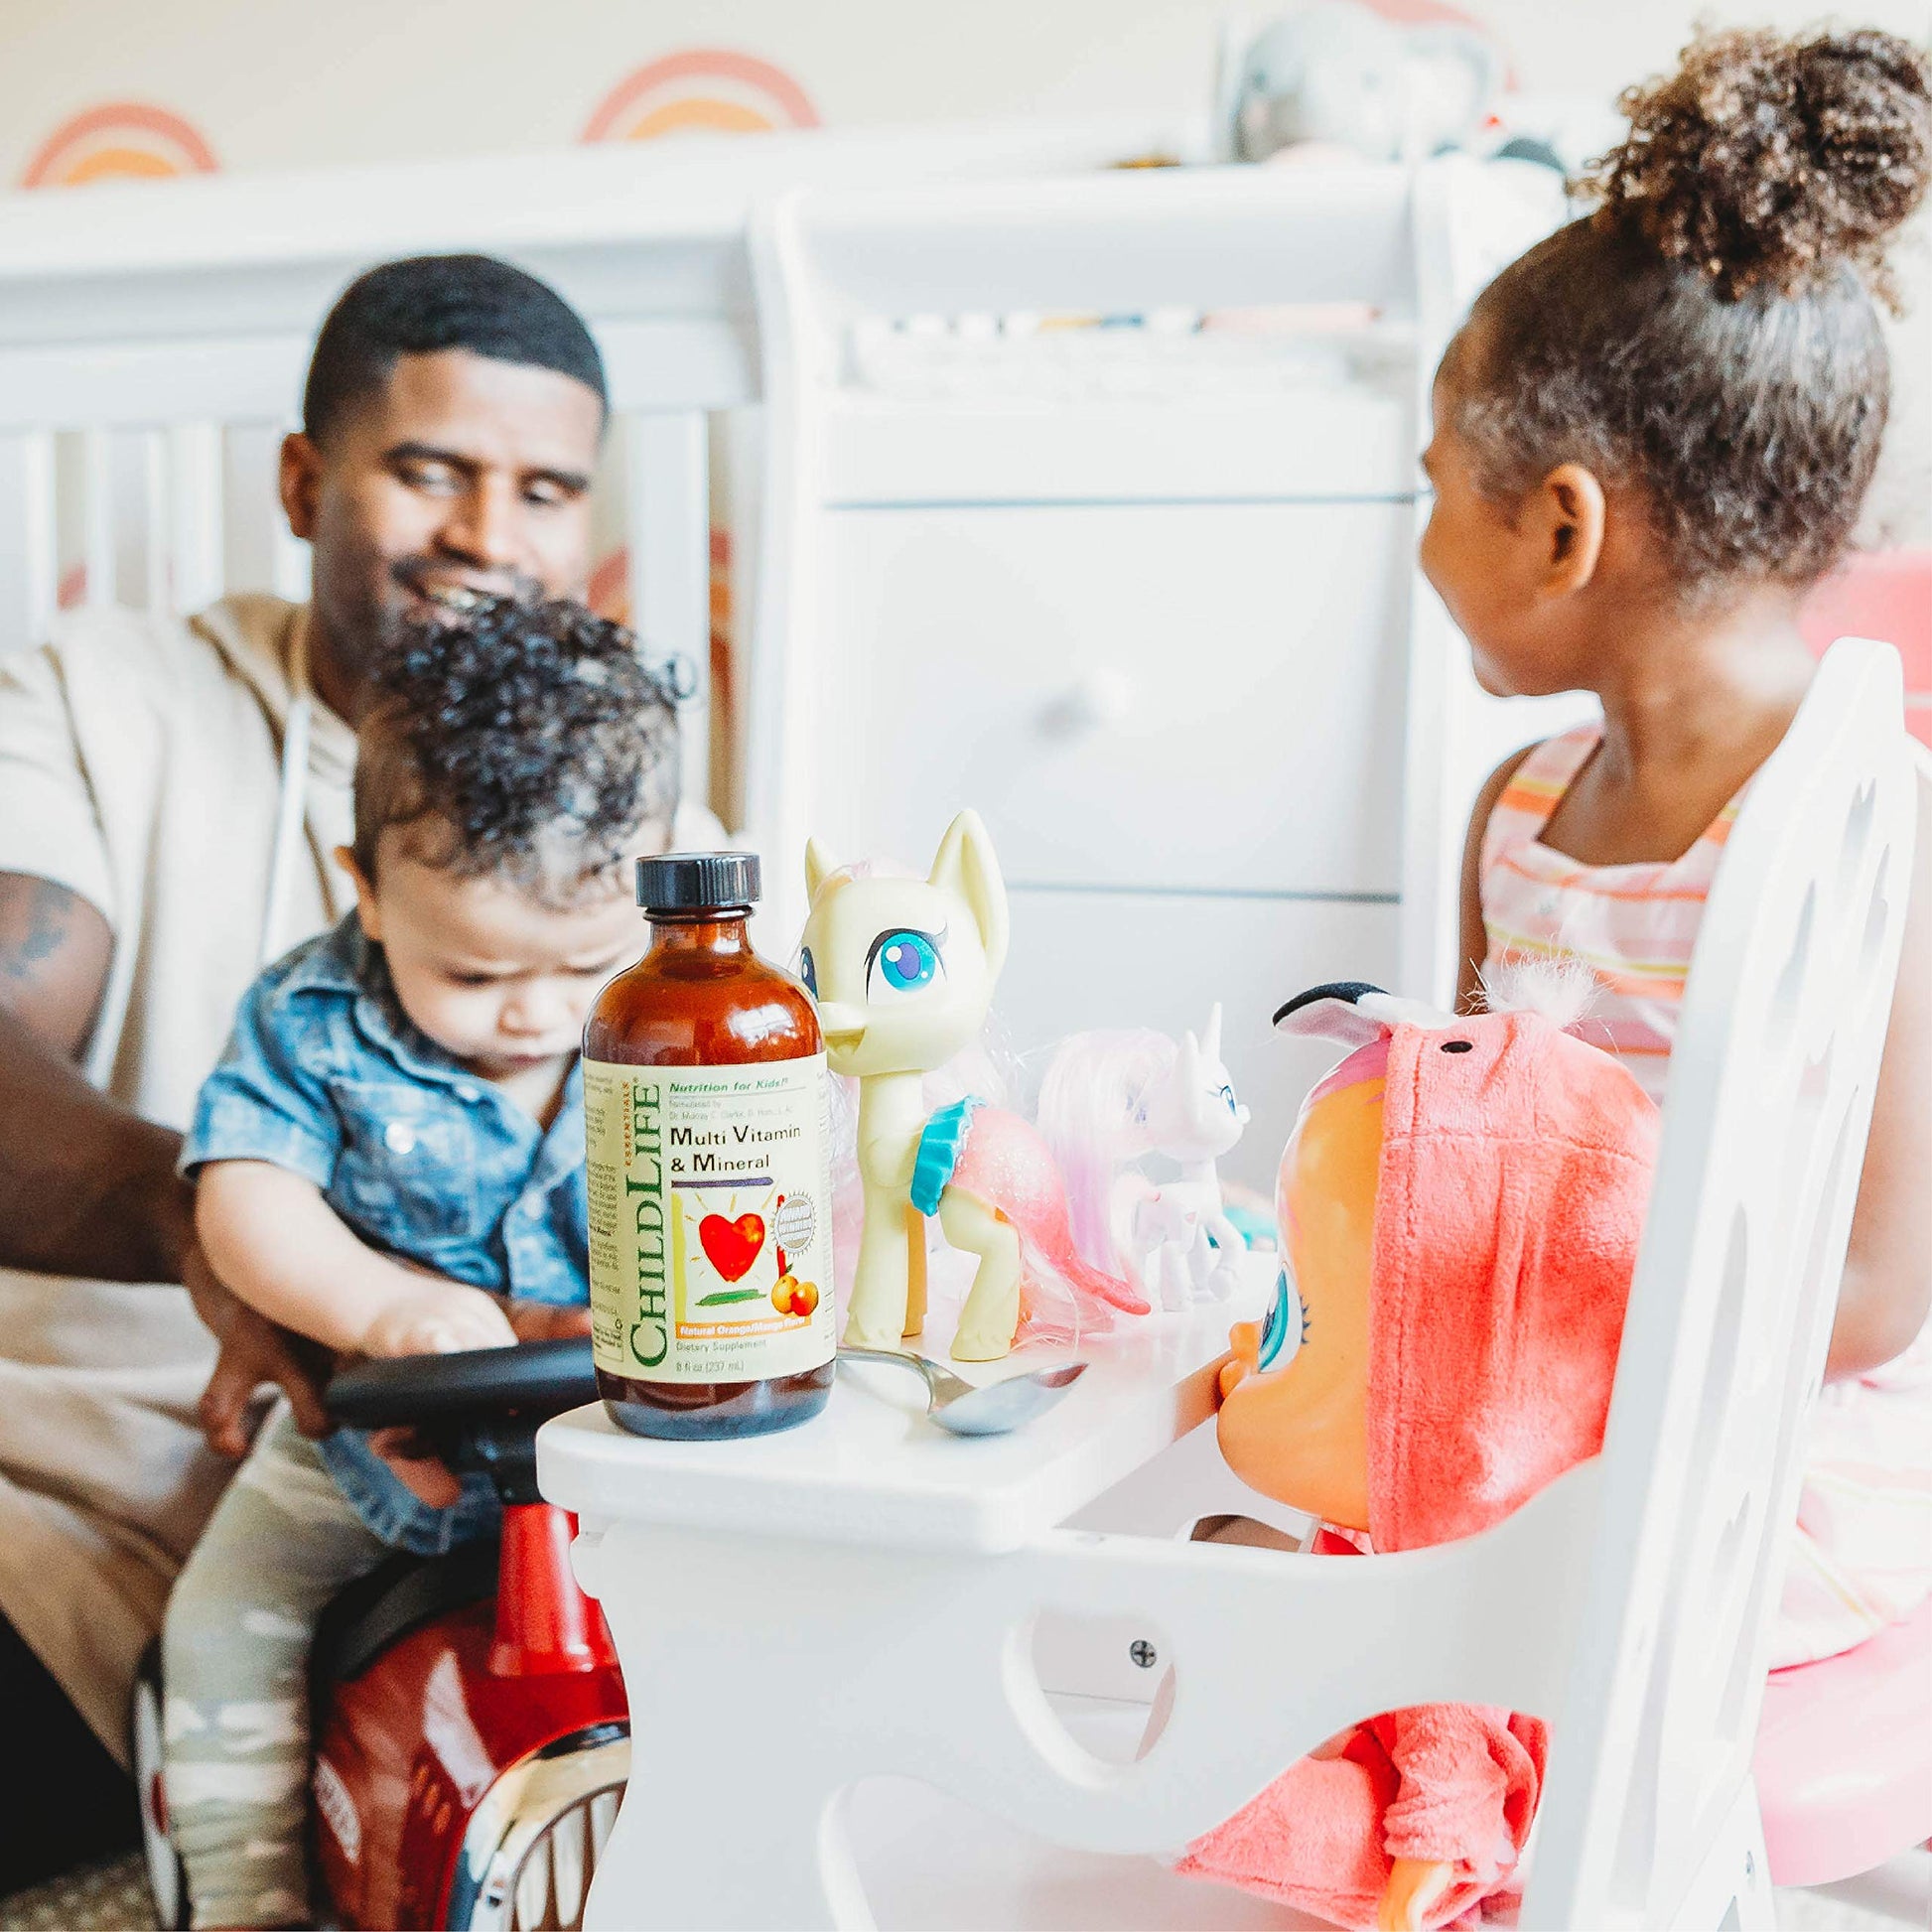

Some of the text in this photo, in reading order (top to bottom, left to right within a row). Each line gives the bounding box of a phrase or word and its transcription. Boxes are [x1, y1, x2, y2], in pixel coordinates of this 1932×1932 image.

[669, 1082, 728, 1093] Nutrition
[734, 1081, 752, 1091] for
[670, 1124, 801, 1146] Multi Vitamin
[671, 1154, 769, 1173] & Mineral
